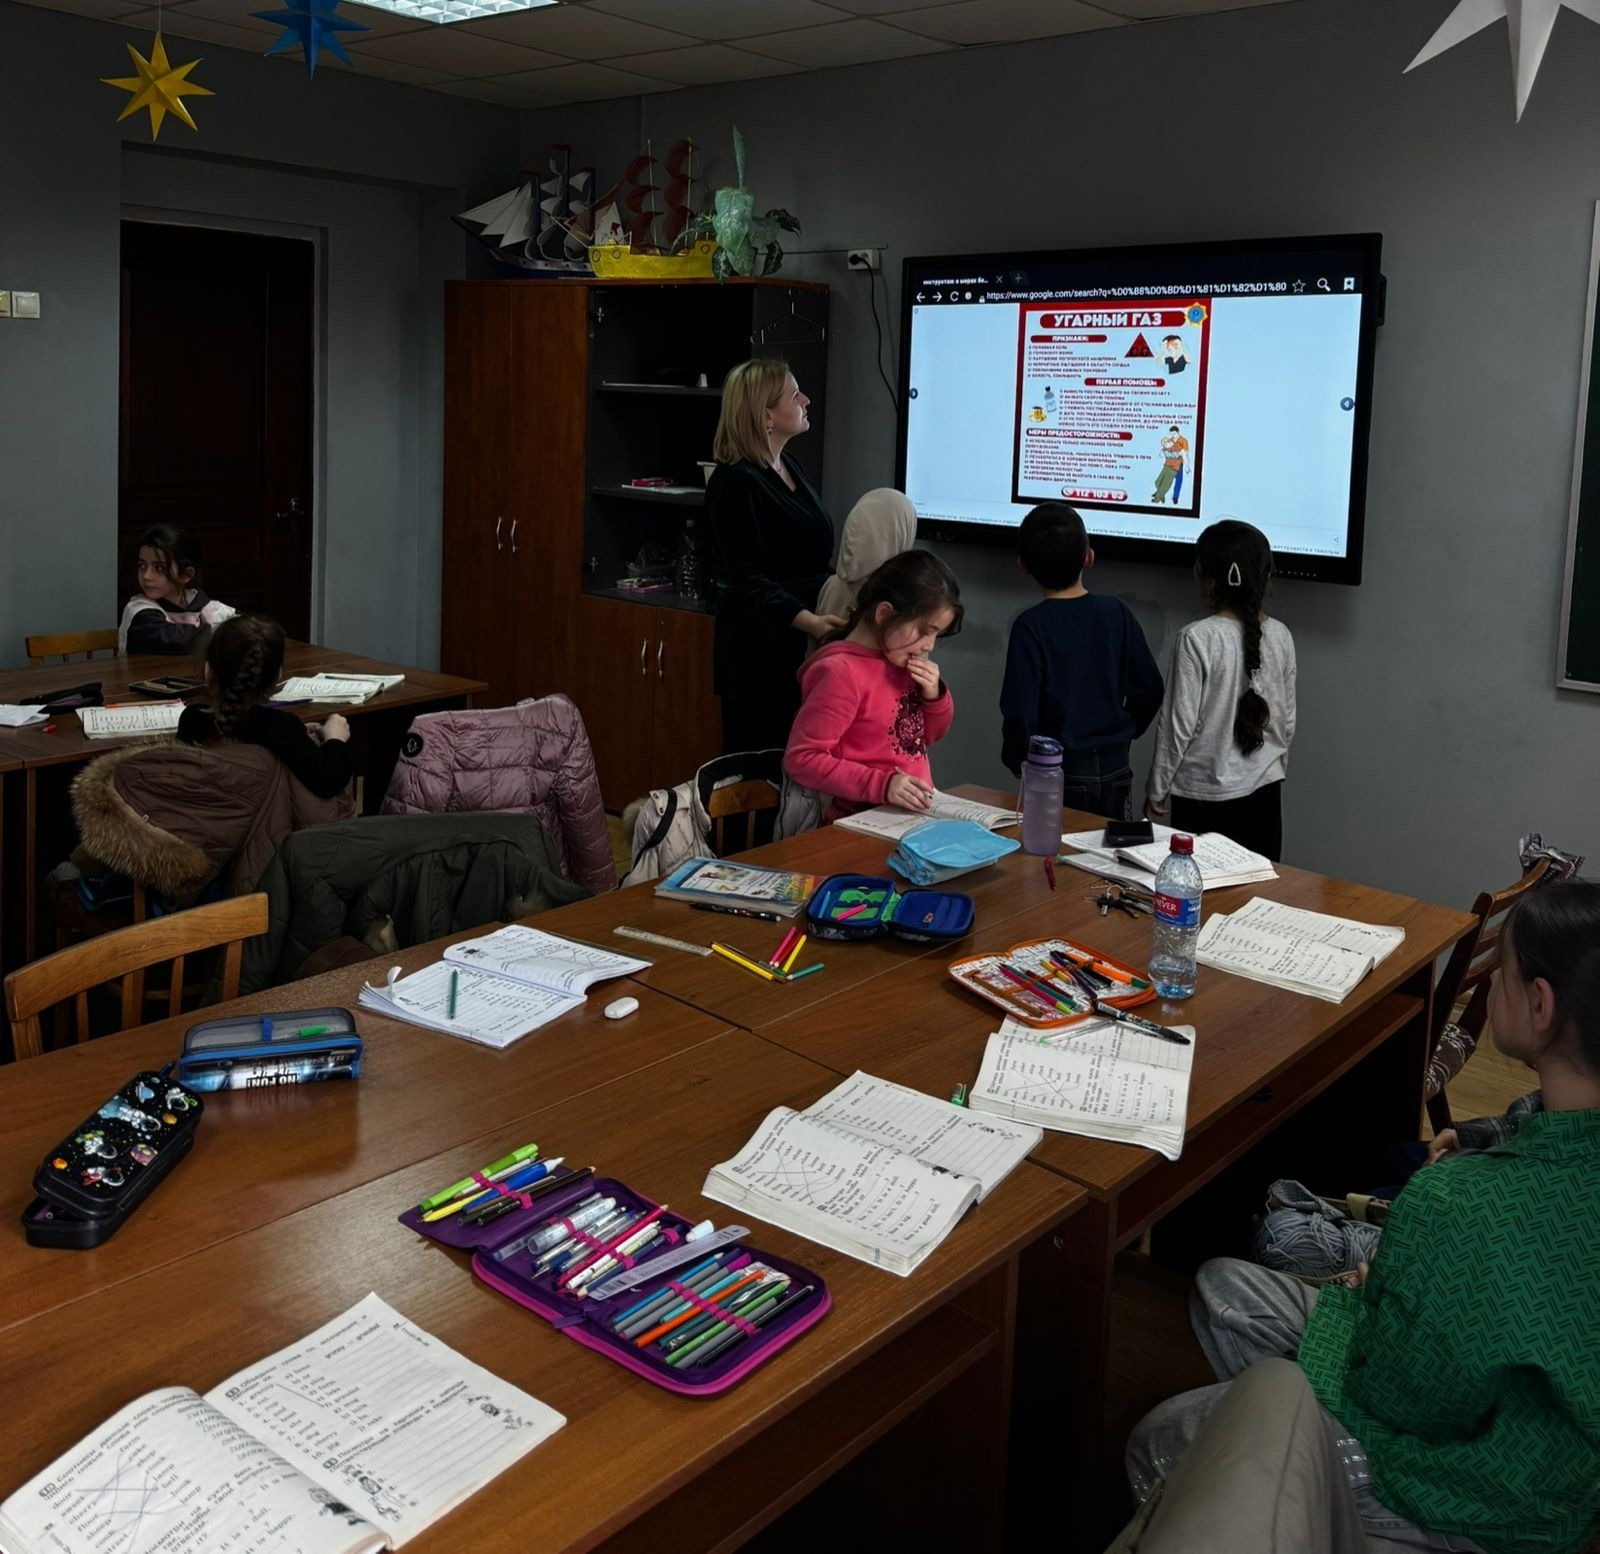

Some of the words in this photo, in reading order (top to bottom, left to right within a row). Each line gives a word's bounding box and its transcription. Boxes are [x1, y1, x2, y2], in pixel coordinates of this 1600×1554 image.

[1054, 313, 1128, 328] УГАРНЫЙ
[1132, 312, 1162, 327] ГАЗ
[1052, 335, 1089, 343] ПРИЗНАКИ:
[1096, 378, 1122, 386] ПЕРВАЯ
